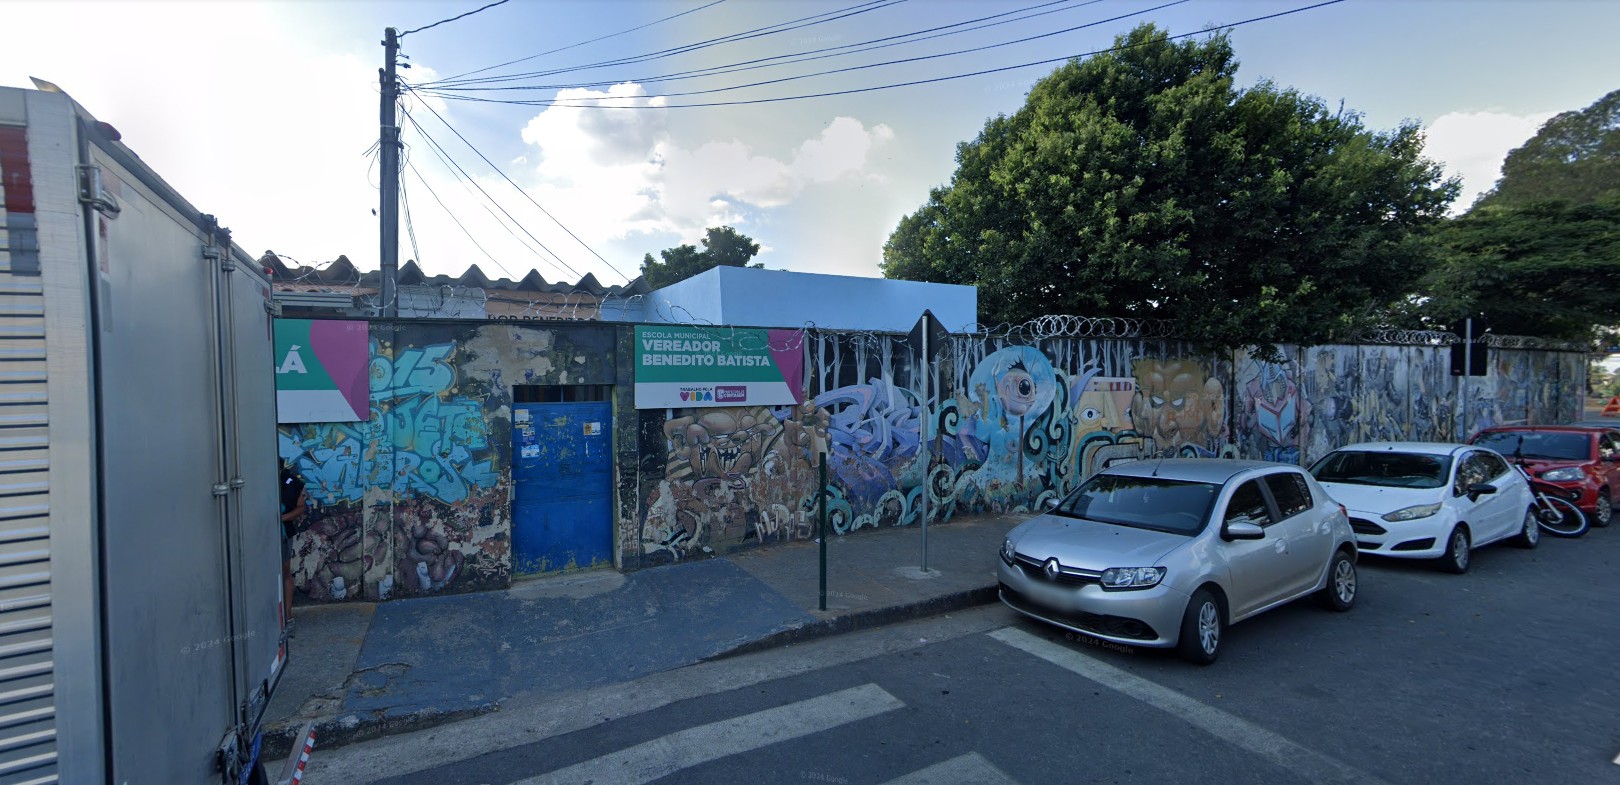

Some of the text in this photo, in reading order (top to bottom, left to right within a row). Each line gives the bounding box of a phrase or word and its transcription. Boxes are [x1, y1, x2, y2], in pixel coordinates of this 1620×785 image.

[643, 331, 672, 339] ESCOLA
[643, 340, 720, 351] VEREADOR
[642, 353, 770, 367] BENEDITO BATISTA
[680, 391, 713, 402] VIDA
